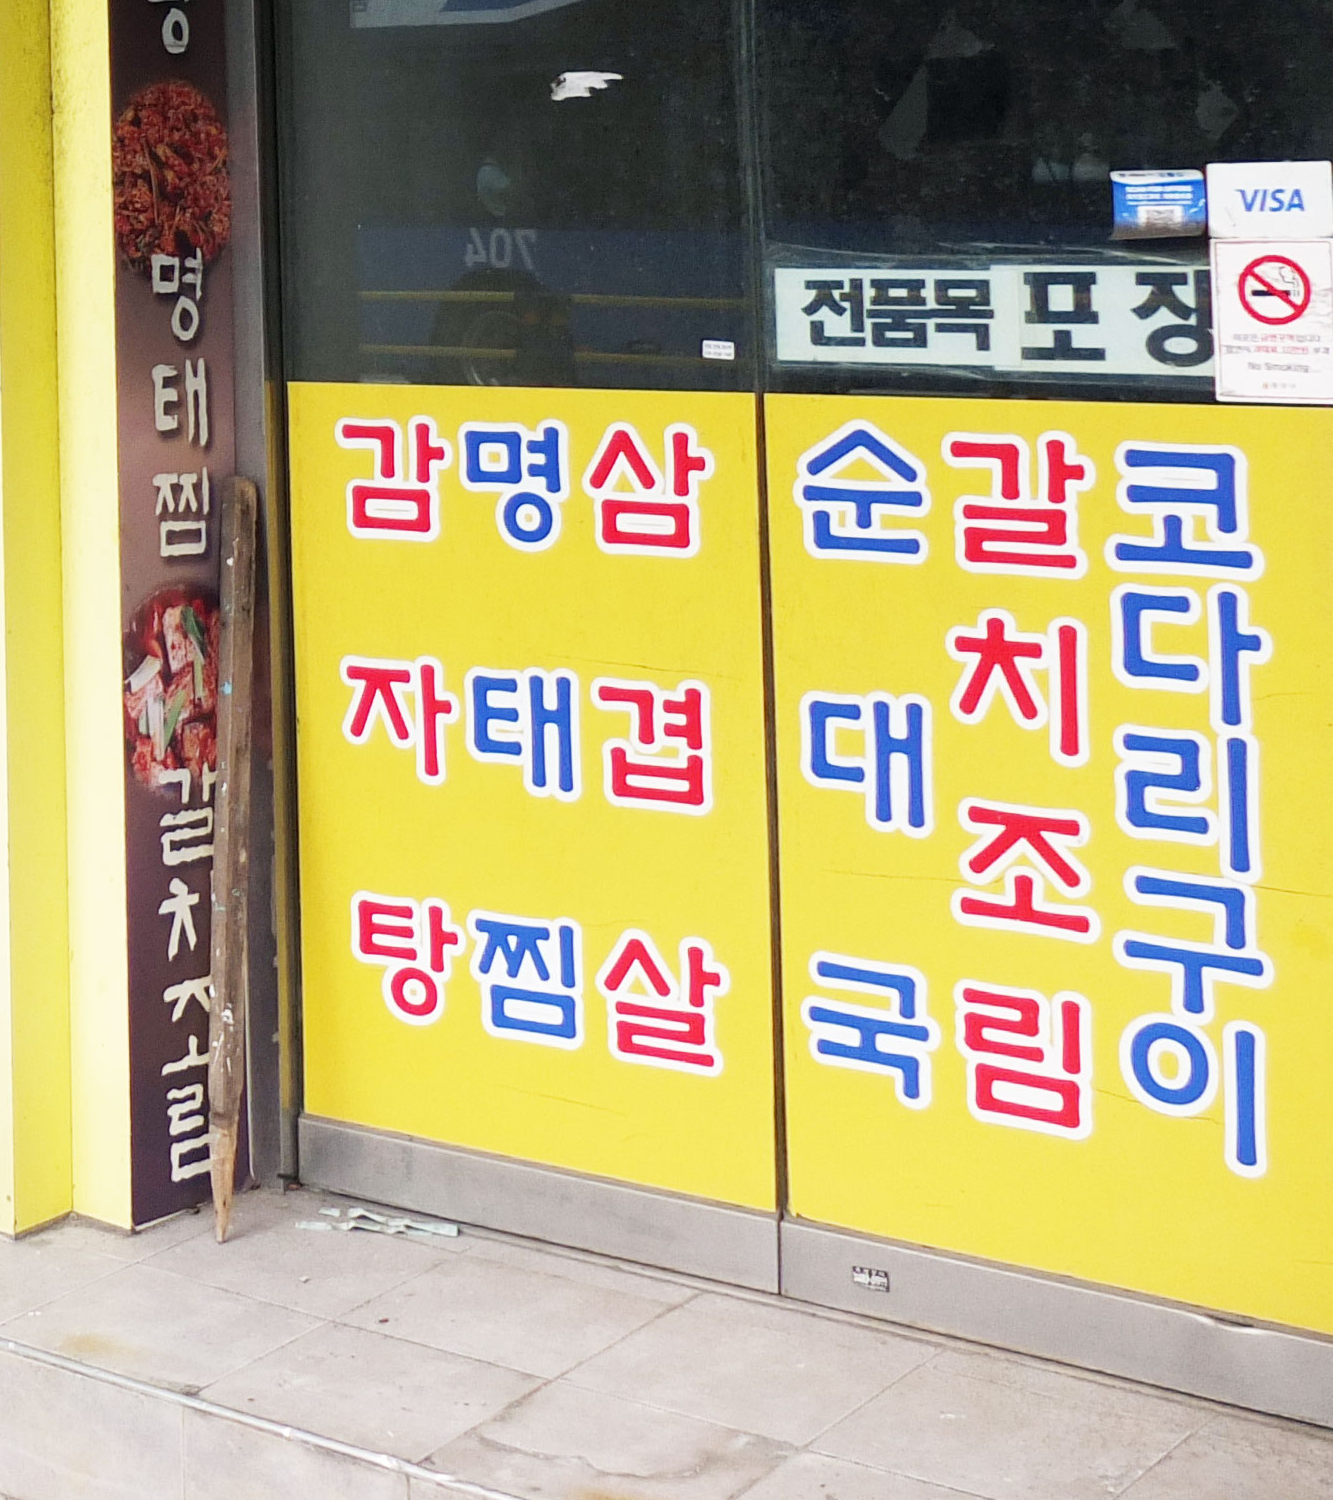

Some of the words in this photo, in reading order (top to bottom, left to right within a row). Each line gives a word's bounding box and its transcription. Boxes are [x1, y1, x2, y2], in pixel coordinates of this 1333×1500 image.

[149, 247, 211, 558] 명태찜
[800, 277, 995, 351] 전품목
[1235, 188, 1306, 213] VISA
[336, 418, 460, 1022] 감자탕
[464, 419, 581, 1044] 명태찜
[587, 425, 725, 1073] 삼겹살
[799, 422, 933, 1104] 순대국
[943, 433, 1096, 1135] 갈치조림
[1109, 442, 1270, 1173] 코다리구이
